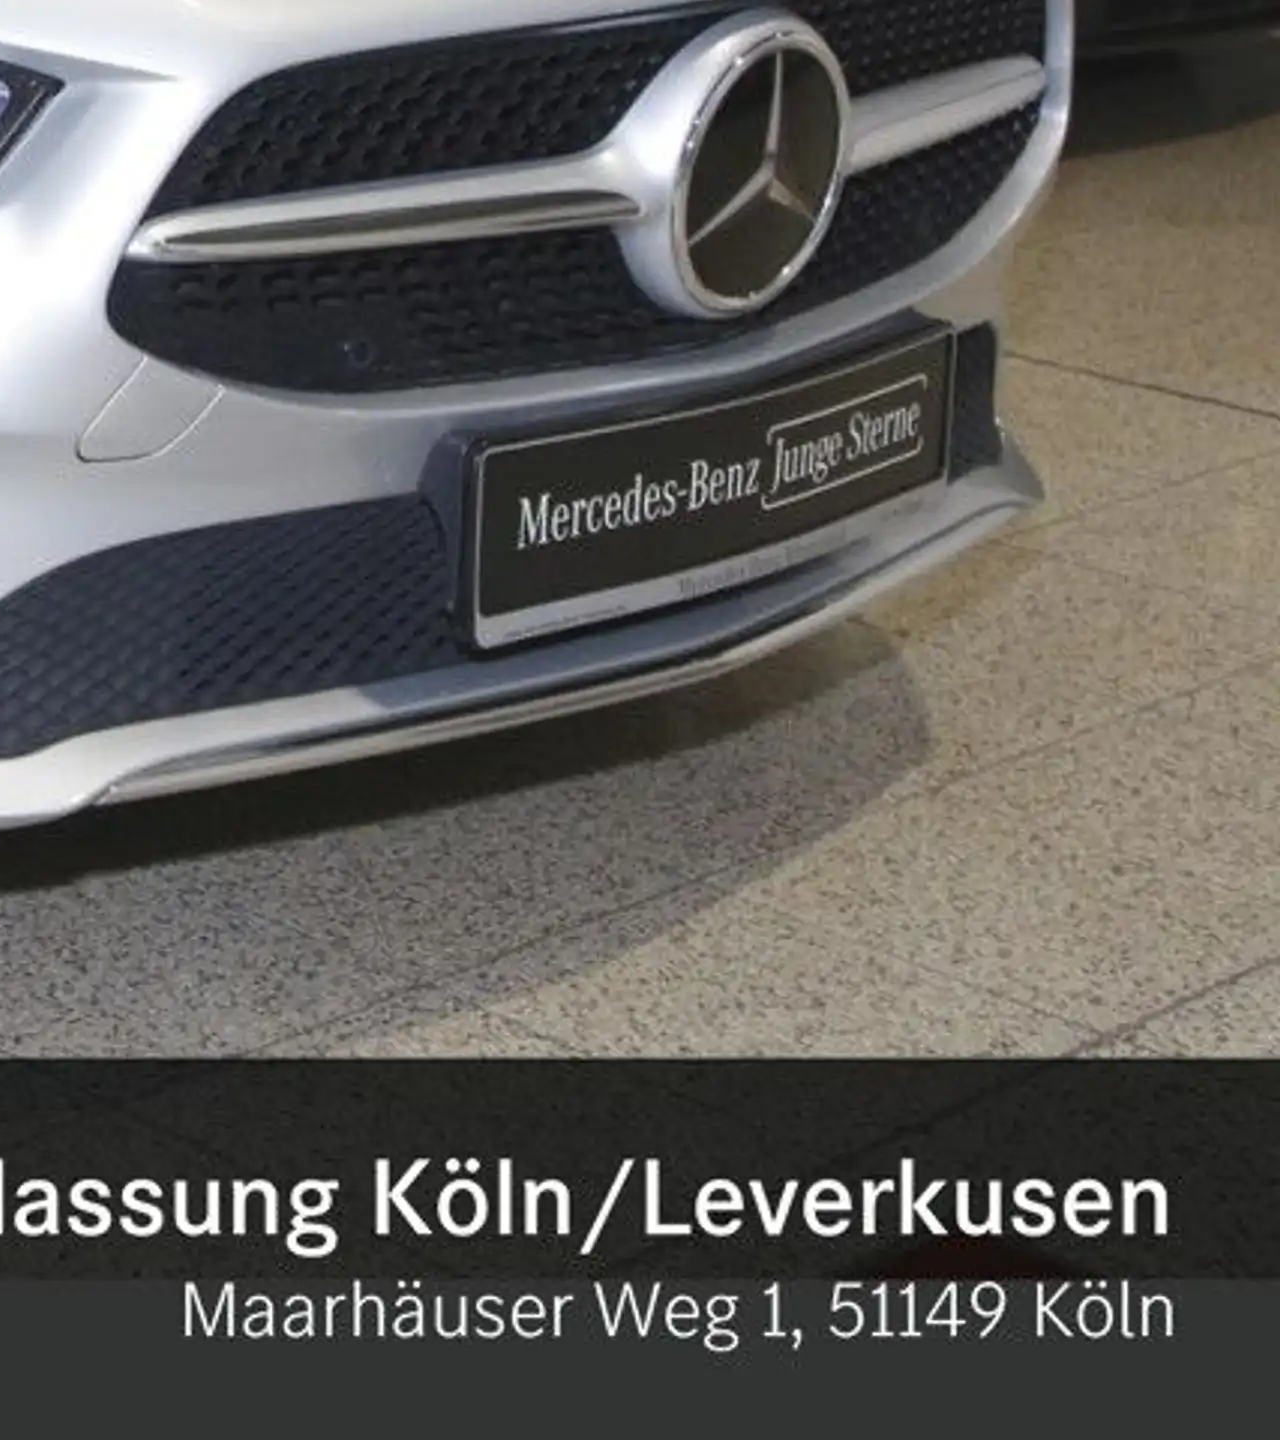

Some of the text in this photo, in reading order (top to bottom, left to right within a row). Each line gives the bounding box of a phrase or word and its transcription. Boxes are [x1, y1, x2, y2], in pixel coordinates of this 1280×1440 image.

[517, 402, 920, 550] Mercedes-Benz Junge Sterne
